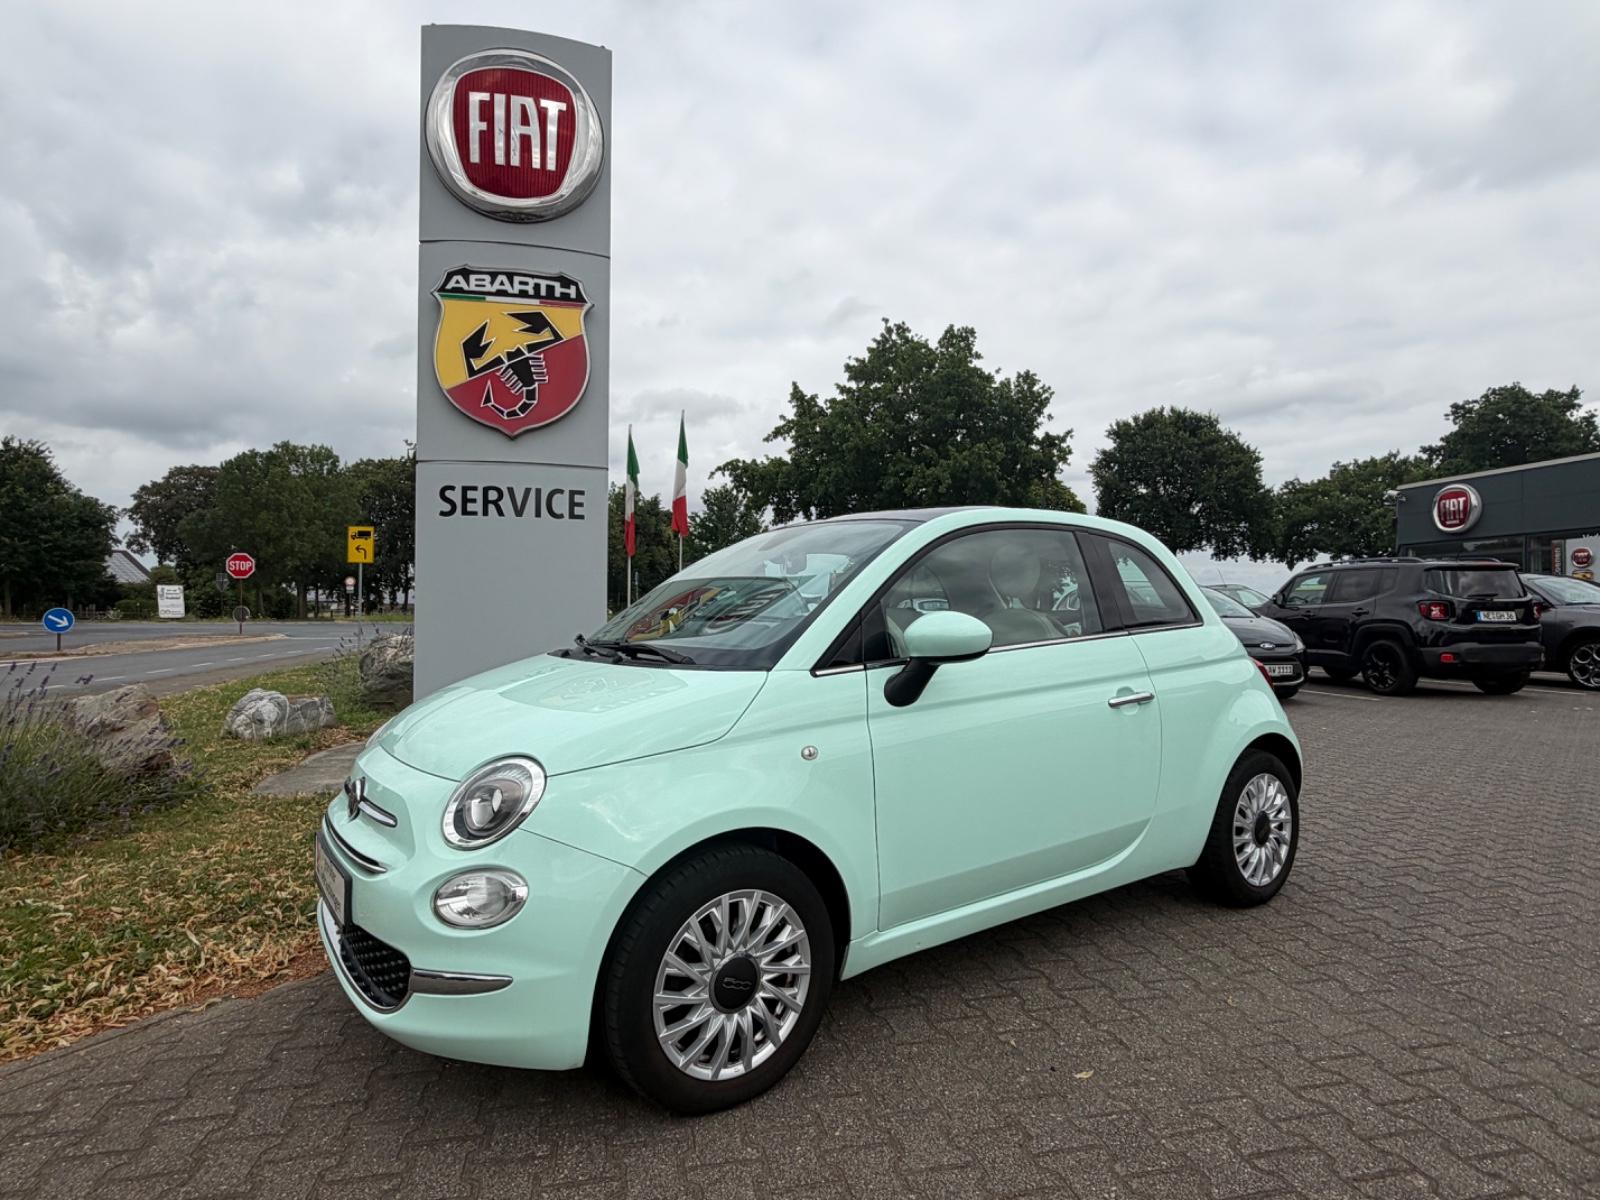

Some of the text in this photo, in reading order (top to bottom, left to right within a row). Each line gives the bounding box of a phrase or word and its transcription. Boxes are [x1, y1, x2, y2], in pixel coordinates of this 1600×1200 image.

[468, 91, 567, 172] FIAT
[445, 274, 577, 299] ABARTH
[438, 484, 586, 520] SERVICE
[1440, 496, 1467, 521] FIAT
[229, 560, 252, 571] STOP
